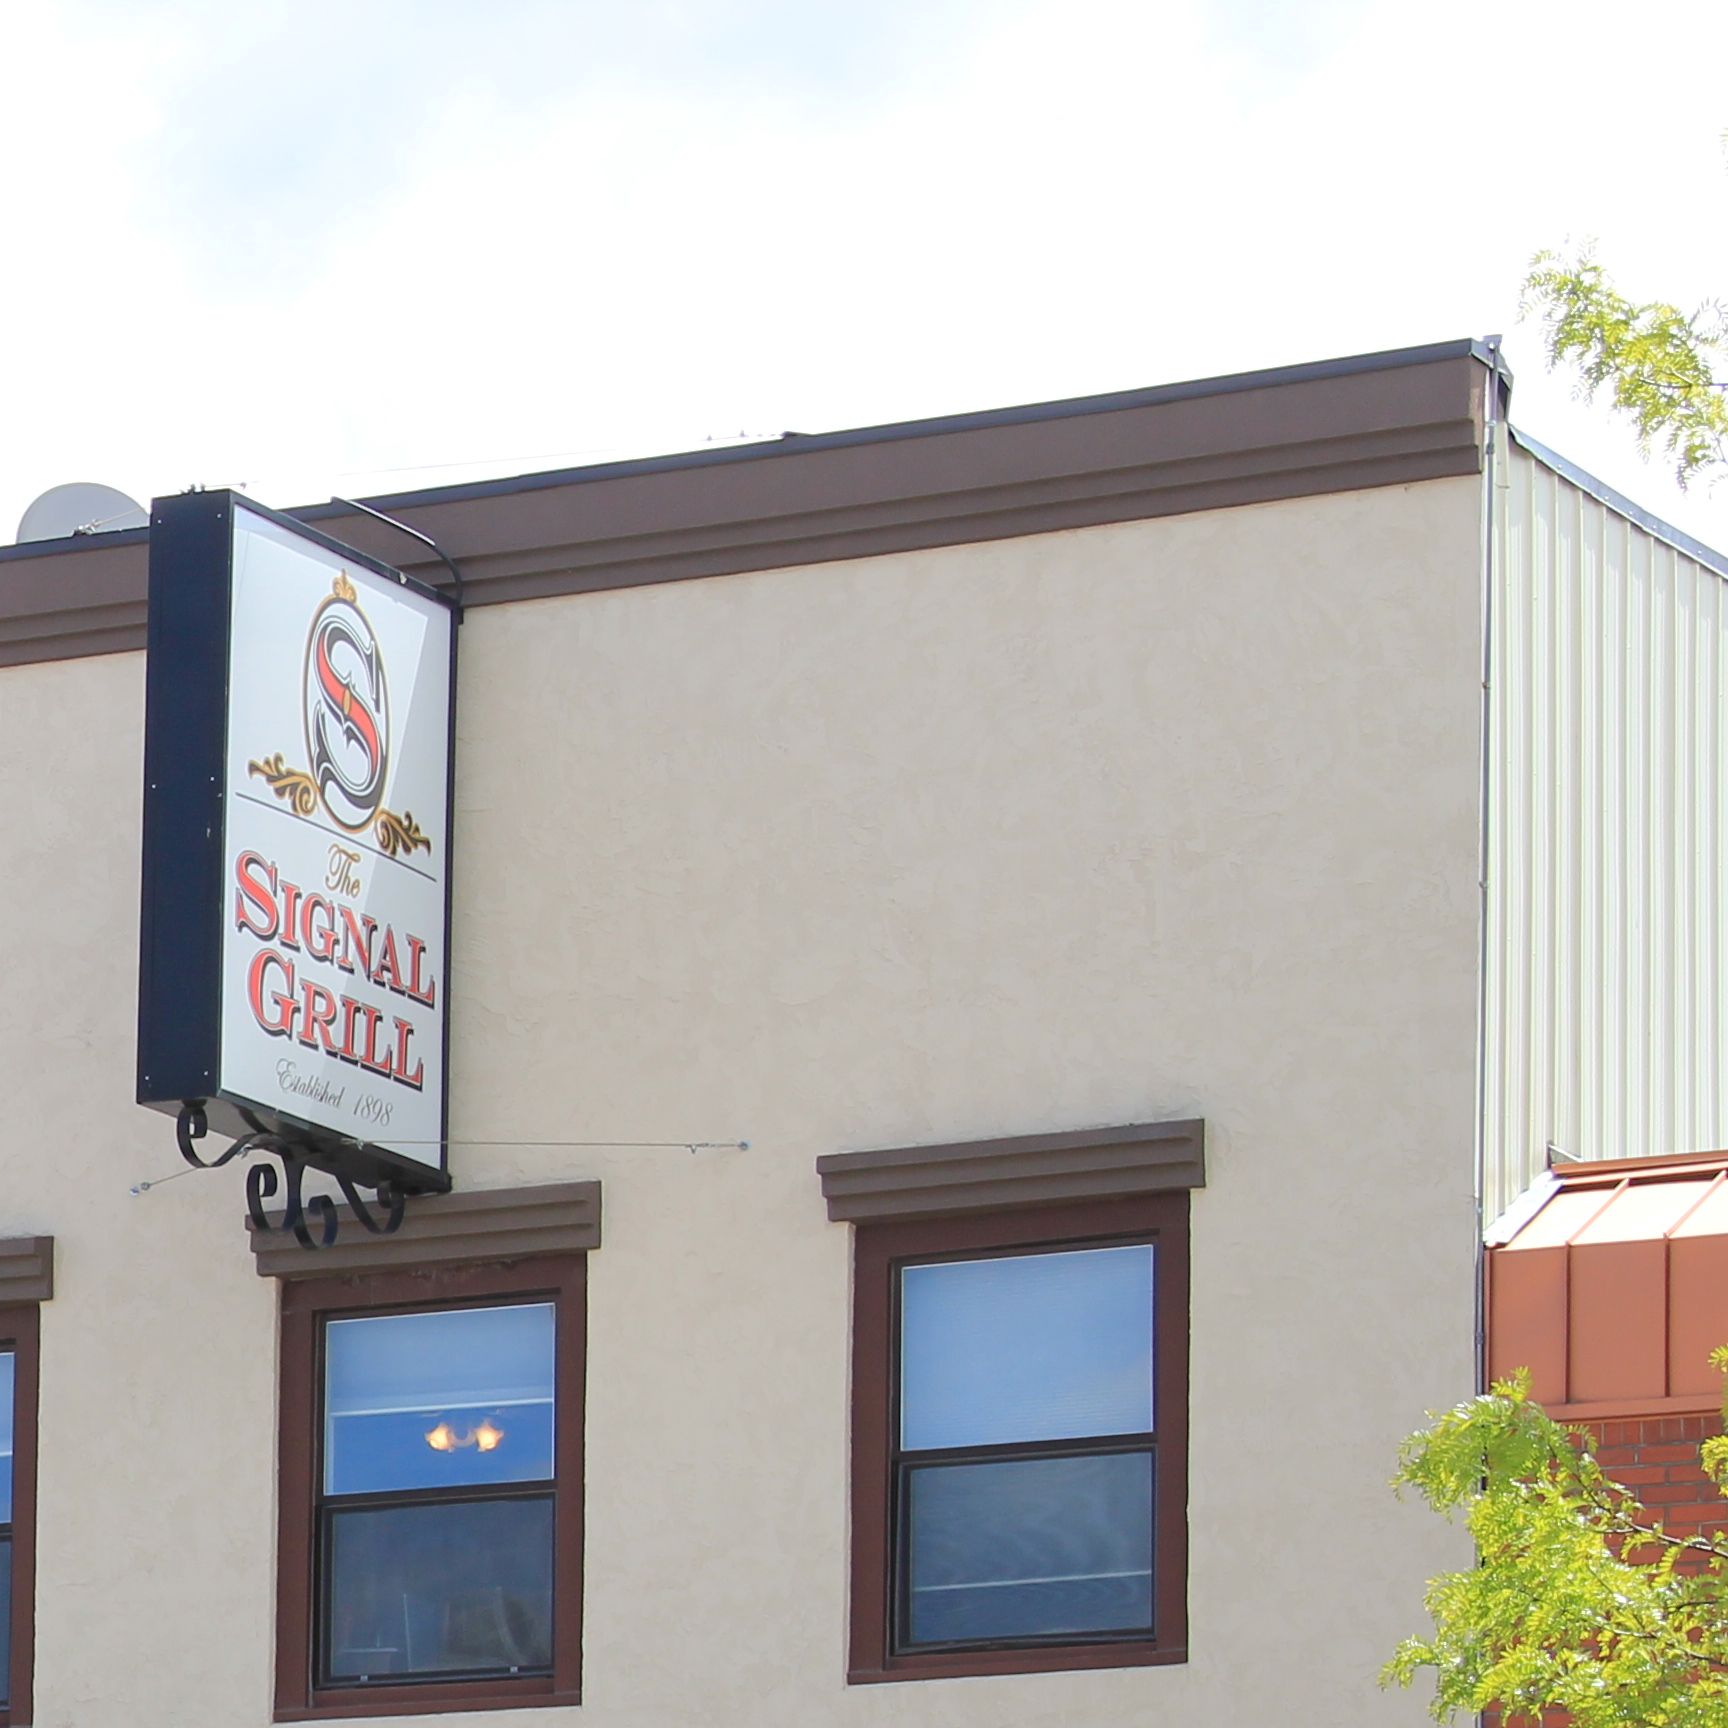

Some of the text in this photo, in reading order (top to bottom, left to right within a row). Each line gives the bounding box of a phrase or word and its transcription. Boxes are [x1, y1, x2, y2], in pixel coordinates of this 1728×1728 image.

[325, 842, 362, 898] The
[233, 849, 435, 1010] SIGNAL
[246, 947, 424, 1091] GRILL
[276, 1057, 394, 1128] Established 1898
